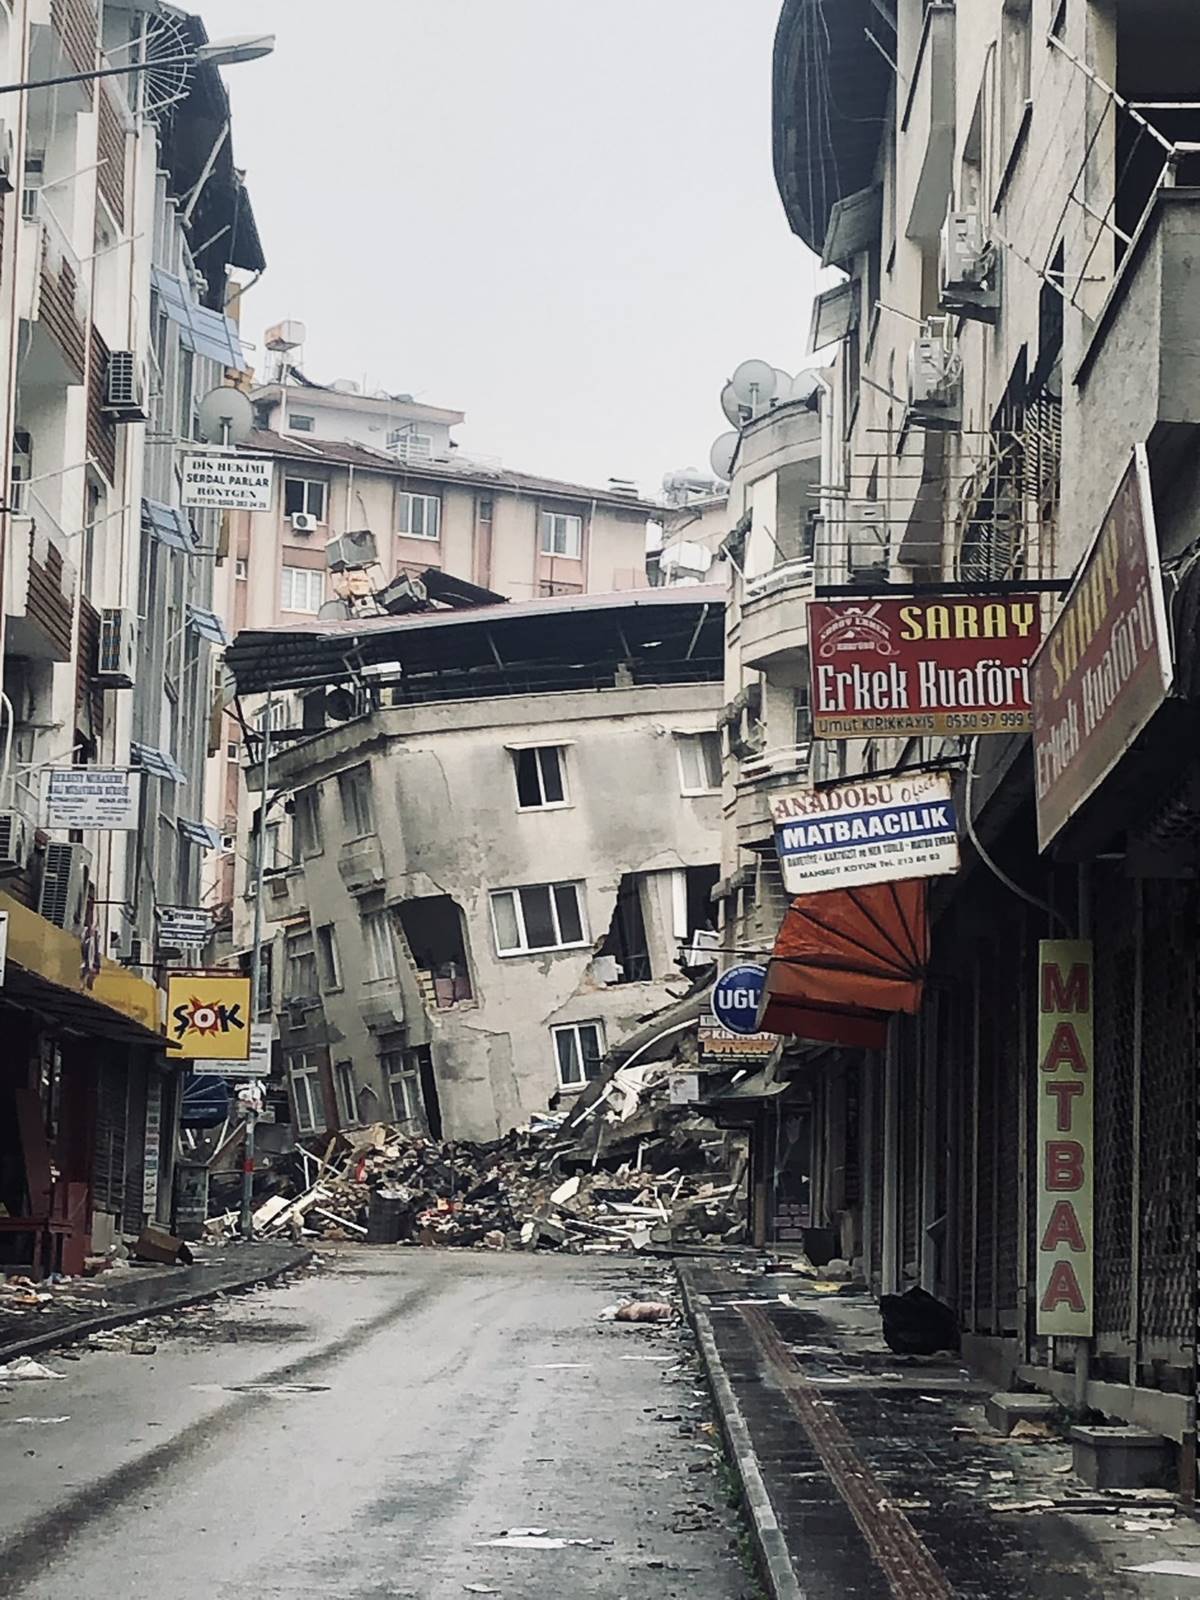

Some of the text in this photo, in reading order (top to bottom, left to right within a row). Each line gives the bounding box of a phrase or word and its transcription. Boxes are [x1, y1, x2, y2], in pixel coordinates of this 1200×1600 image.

[186, 473, 269, 488] SERDAL PARLAR
[900, 603, 1034, 641] SARAY
[1051, 518, 1120, 700] SARAY
[816, 662, 909, 712] Erkek
[1036, 576, 1153, 800] Erkek Kuaförü
[818, 719, 859, 733] Umut
[946, 714, 977, 729] 0530
[981, 713, 996, 728] 97
[1000, 712, 1024, 727] 999
[775, 784, 894, 819] ANADOLU
[782, 806, 949, 850] MATBAACILIK
[173, 1003, 245, 1040] ŞOK
[1040, 961, 1090, 1313] MATBAA
